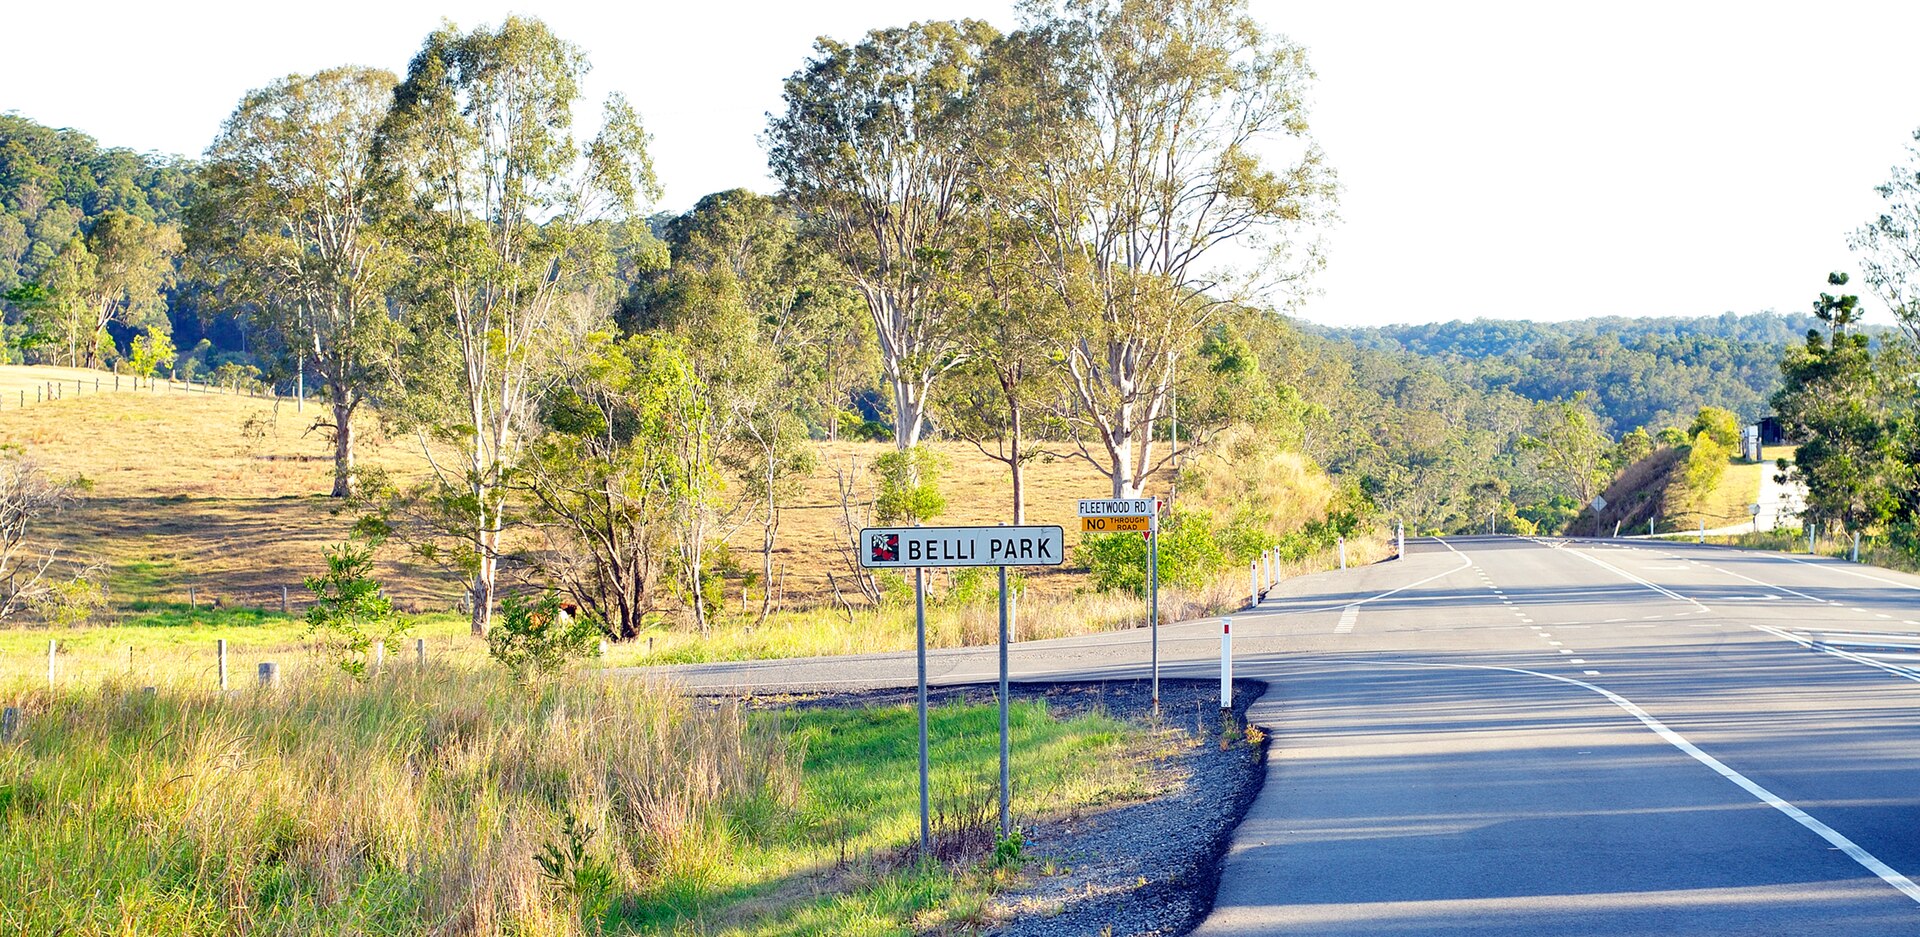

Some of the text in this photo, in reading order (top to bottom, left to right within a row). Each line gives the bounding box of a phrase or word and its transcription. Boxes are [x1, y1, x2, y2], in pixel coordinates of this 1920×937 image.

[1080, 501, 1146, 514] FLEETWOOD RD
[1086, 518, 1106, 530] NO
[908, 538, 1051, 560] BELLI PARK
